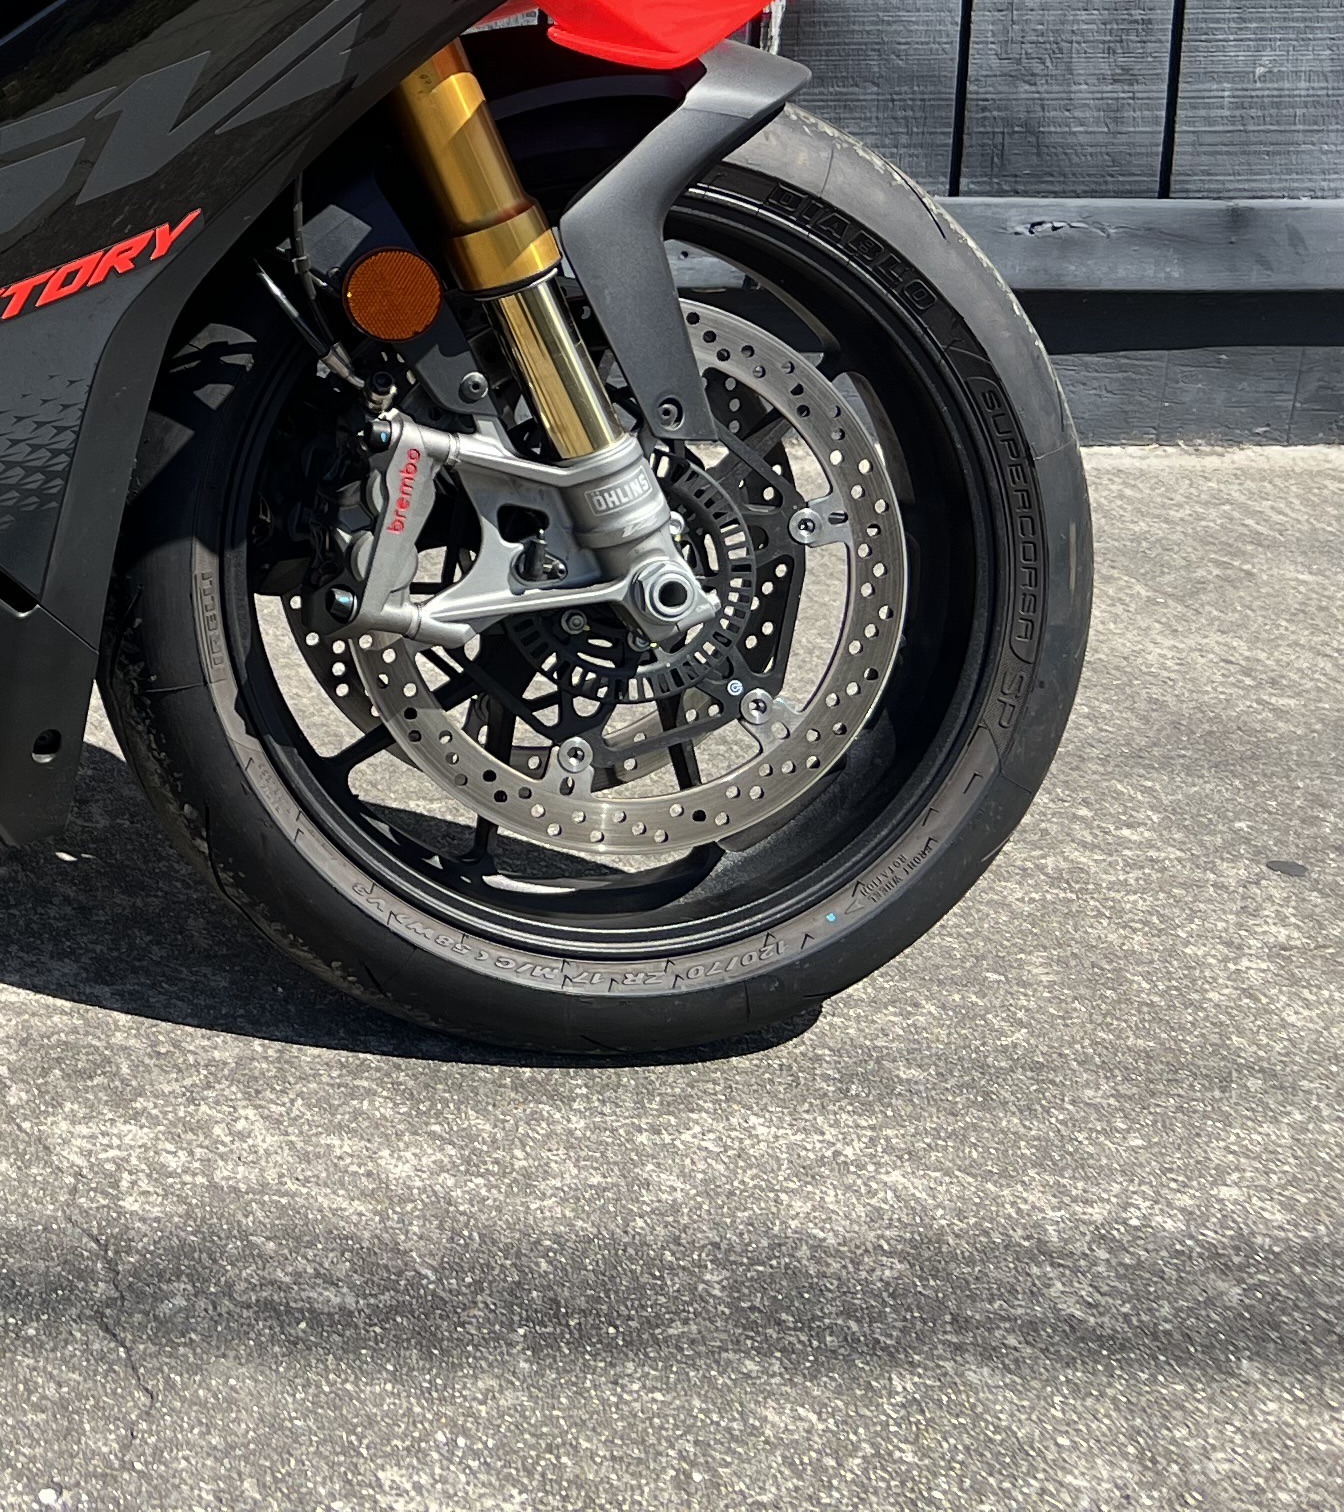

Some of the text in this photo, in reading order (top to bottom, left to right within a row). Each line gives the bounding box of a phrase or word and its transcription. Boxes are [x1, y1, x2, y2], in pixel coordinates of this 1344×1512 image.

[767, 182, 938, 311] DIABLO
[386, 447, 421, 534] brembo
[591, 472, 650, 512] ÖHLINS
[980, 389, 1040, 731] SUPERCORSA SP
[194, 571, 227, 684] PIRELLI
[859, 853, 907, 897] ROTATION
[868, 875, 903, 904] WHEEL
[395, 912, 488, 961] (58W)
[495, 957, 558, 978] M/C
[623, 971, 665, 984] ZR
[686, 940, 786, 979] 120/70
